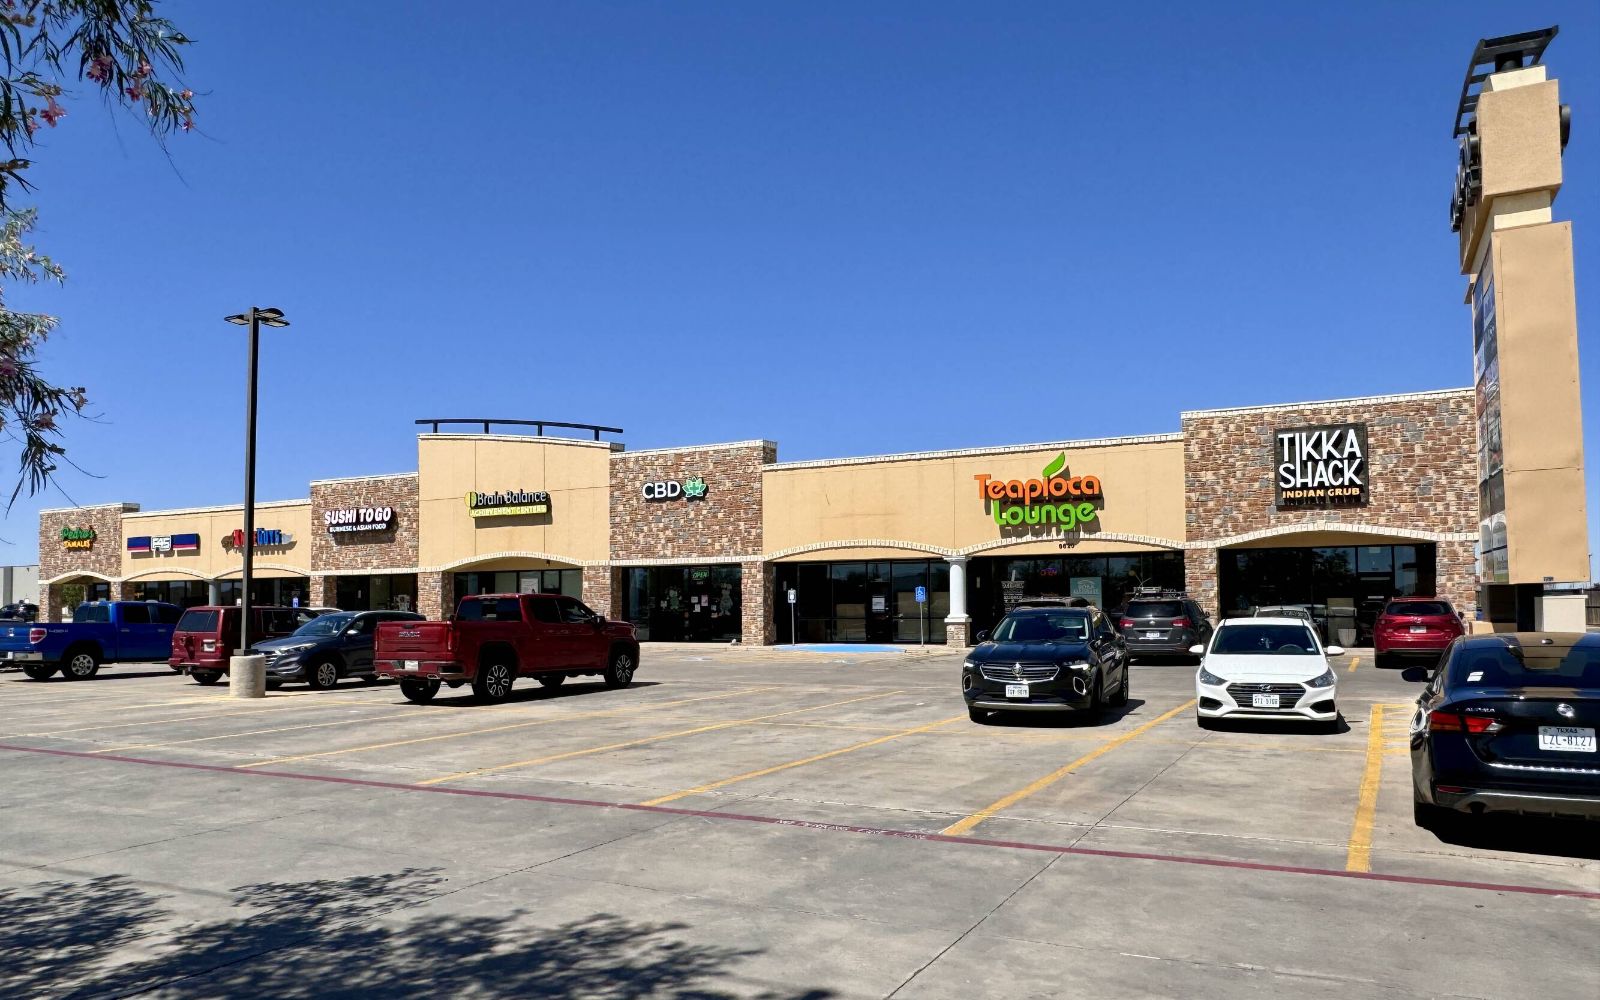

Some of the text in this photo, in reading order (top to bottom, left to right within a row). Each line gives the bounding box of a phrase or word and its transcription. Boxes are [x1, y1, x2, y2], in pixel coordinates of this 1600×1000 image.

[1277, 428, 1362, 461] TIKKA
[1278, 459, 1364, 488] SHACK
[477, 490, 547, 506] Brain Balance
[642, 480, 681, 499] CBD
[973, 473, 1101, 506] Teapioca
[1282, 487, 1360, 499] INDIAN GRUB
[324, 508, 357, 525] SUSHI
[992, 500, 1096, 531] Lounge
